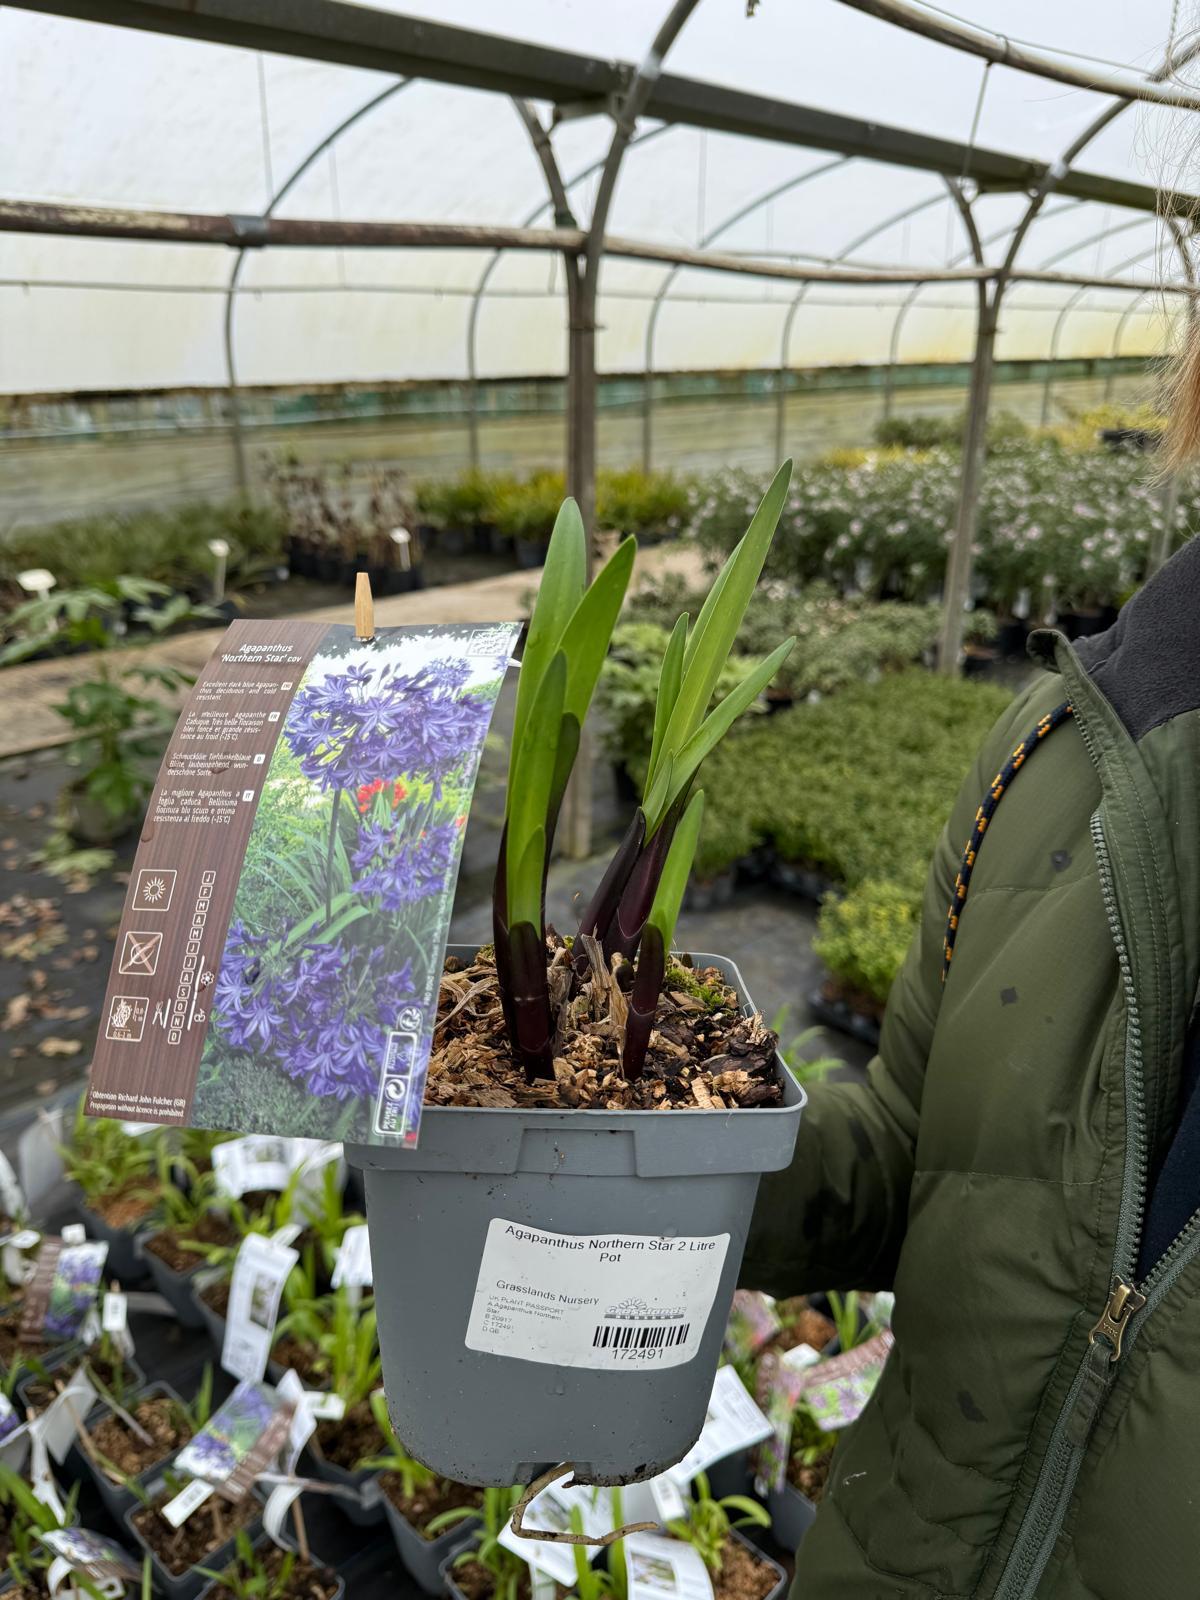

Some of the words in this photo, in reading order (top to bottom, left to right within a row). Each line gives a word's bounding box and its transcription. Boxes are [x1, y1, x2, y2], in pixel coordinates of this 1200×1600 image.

[239, 644, 294, 654] Agapanthus
[197, 789, 232, 799] Agapanthus
[190, 814, 211, 823] freddo
[92, 1091, 117, 1100] Obtention
[118, 1093, 138, 1102] Richard
[139, 1095, 152, 1104] John
[152, 1096, 173, 1106] Fulcher
[117, 1104, 135, 1112] without
[135, 1105, 153, 1114] licence
[504, 1224, 585, 1250] Agapanthus
[588, 1238, 645, 1250] Northern
[648, 1239, 676, 1251] Star
[677, 1240, 687, 1251] 2
[689, 1240, 716, 1251] Litre
[599, 1252, 621, 1263] Pot
[496, 1279, 556, 1301] Grasslands
[558, 1293, 600, 1306] Nursery
[493, 1302, 533, 1315] Agapanthus
[500, 1296, 524, 1306] PLANT
[525, 1301, 565, 1316] PASSPORT
[611, 1348, 664, 1360] 172491
